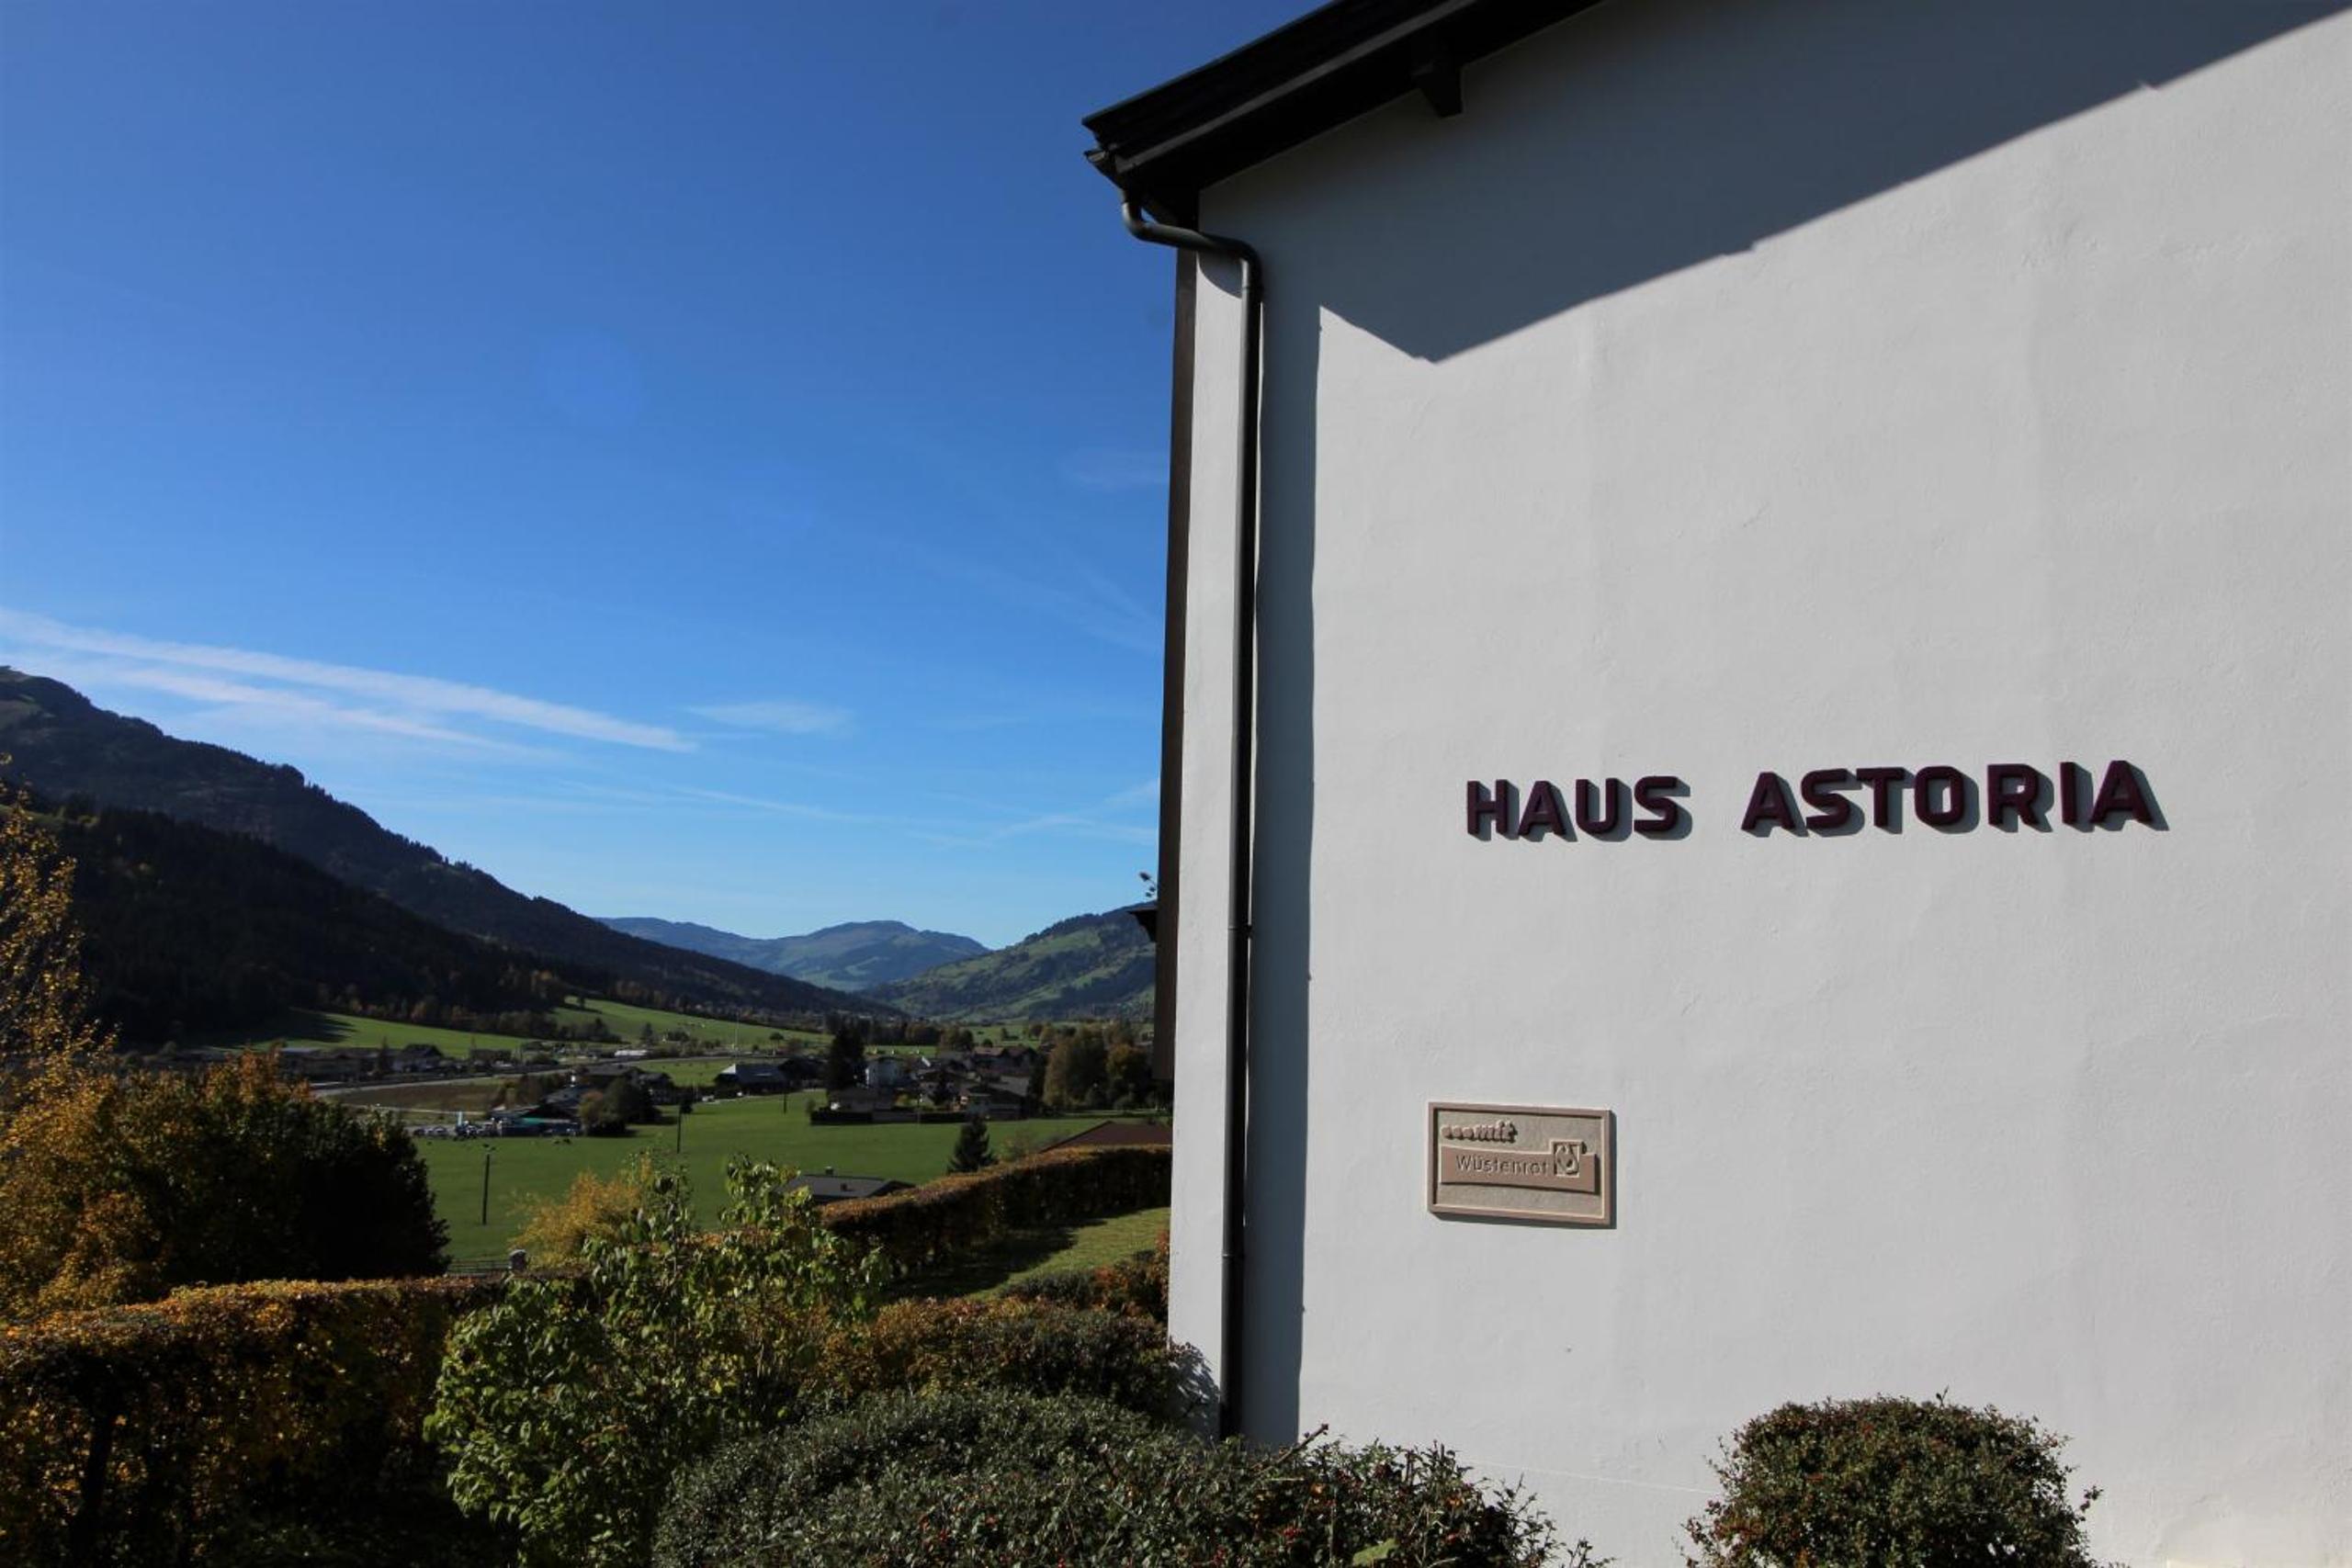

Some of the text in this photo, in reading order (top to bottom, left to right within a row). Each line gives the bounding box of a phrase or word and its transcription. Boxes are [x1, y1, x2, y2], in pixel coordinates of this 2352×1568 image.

[1467, 760, 2155, 835] HAUS ASTORIA
[1455, 1154, 1548, 1176] Wüstenrot
